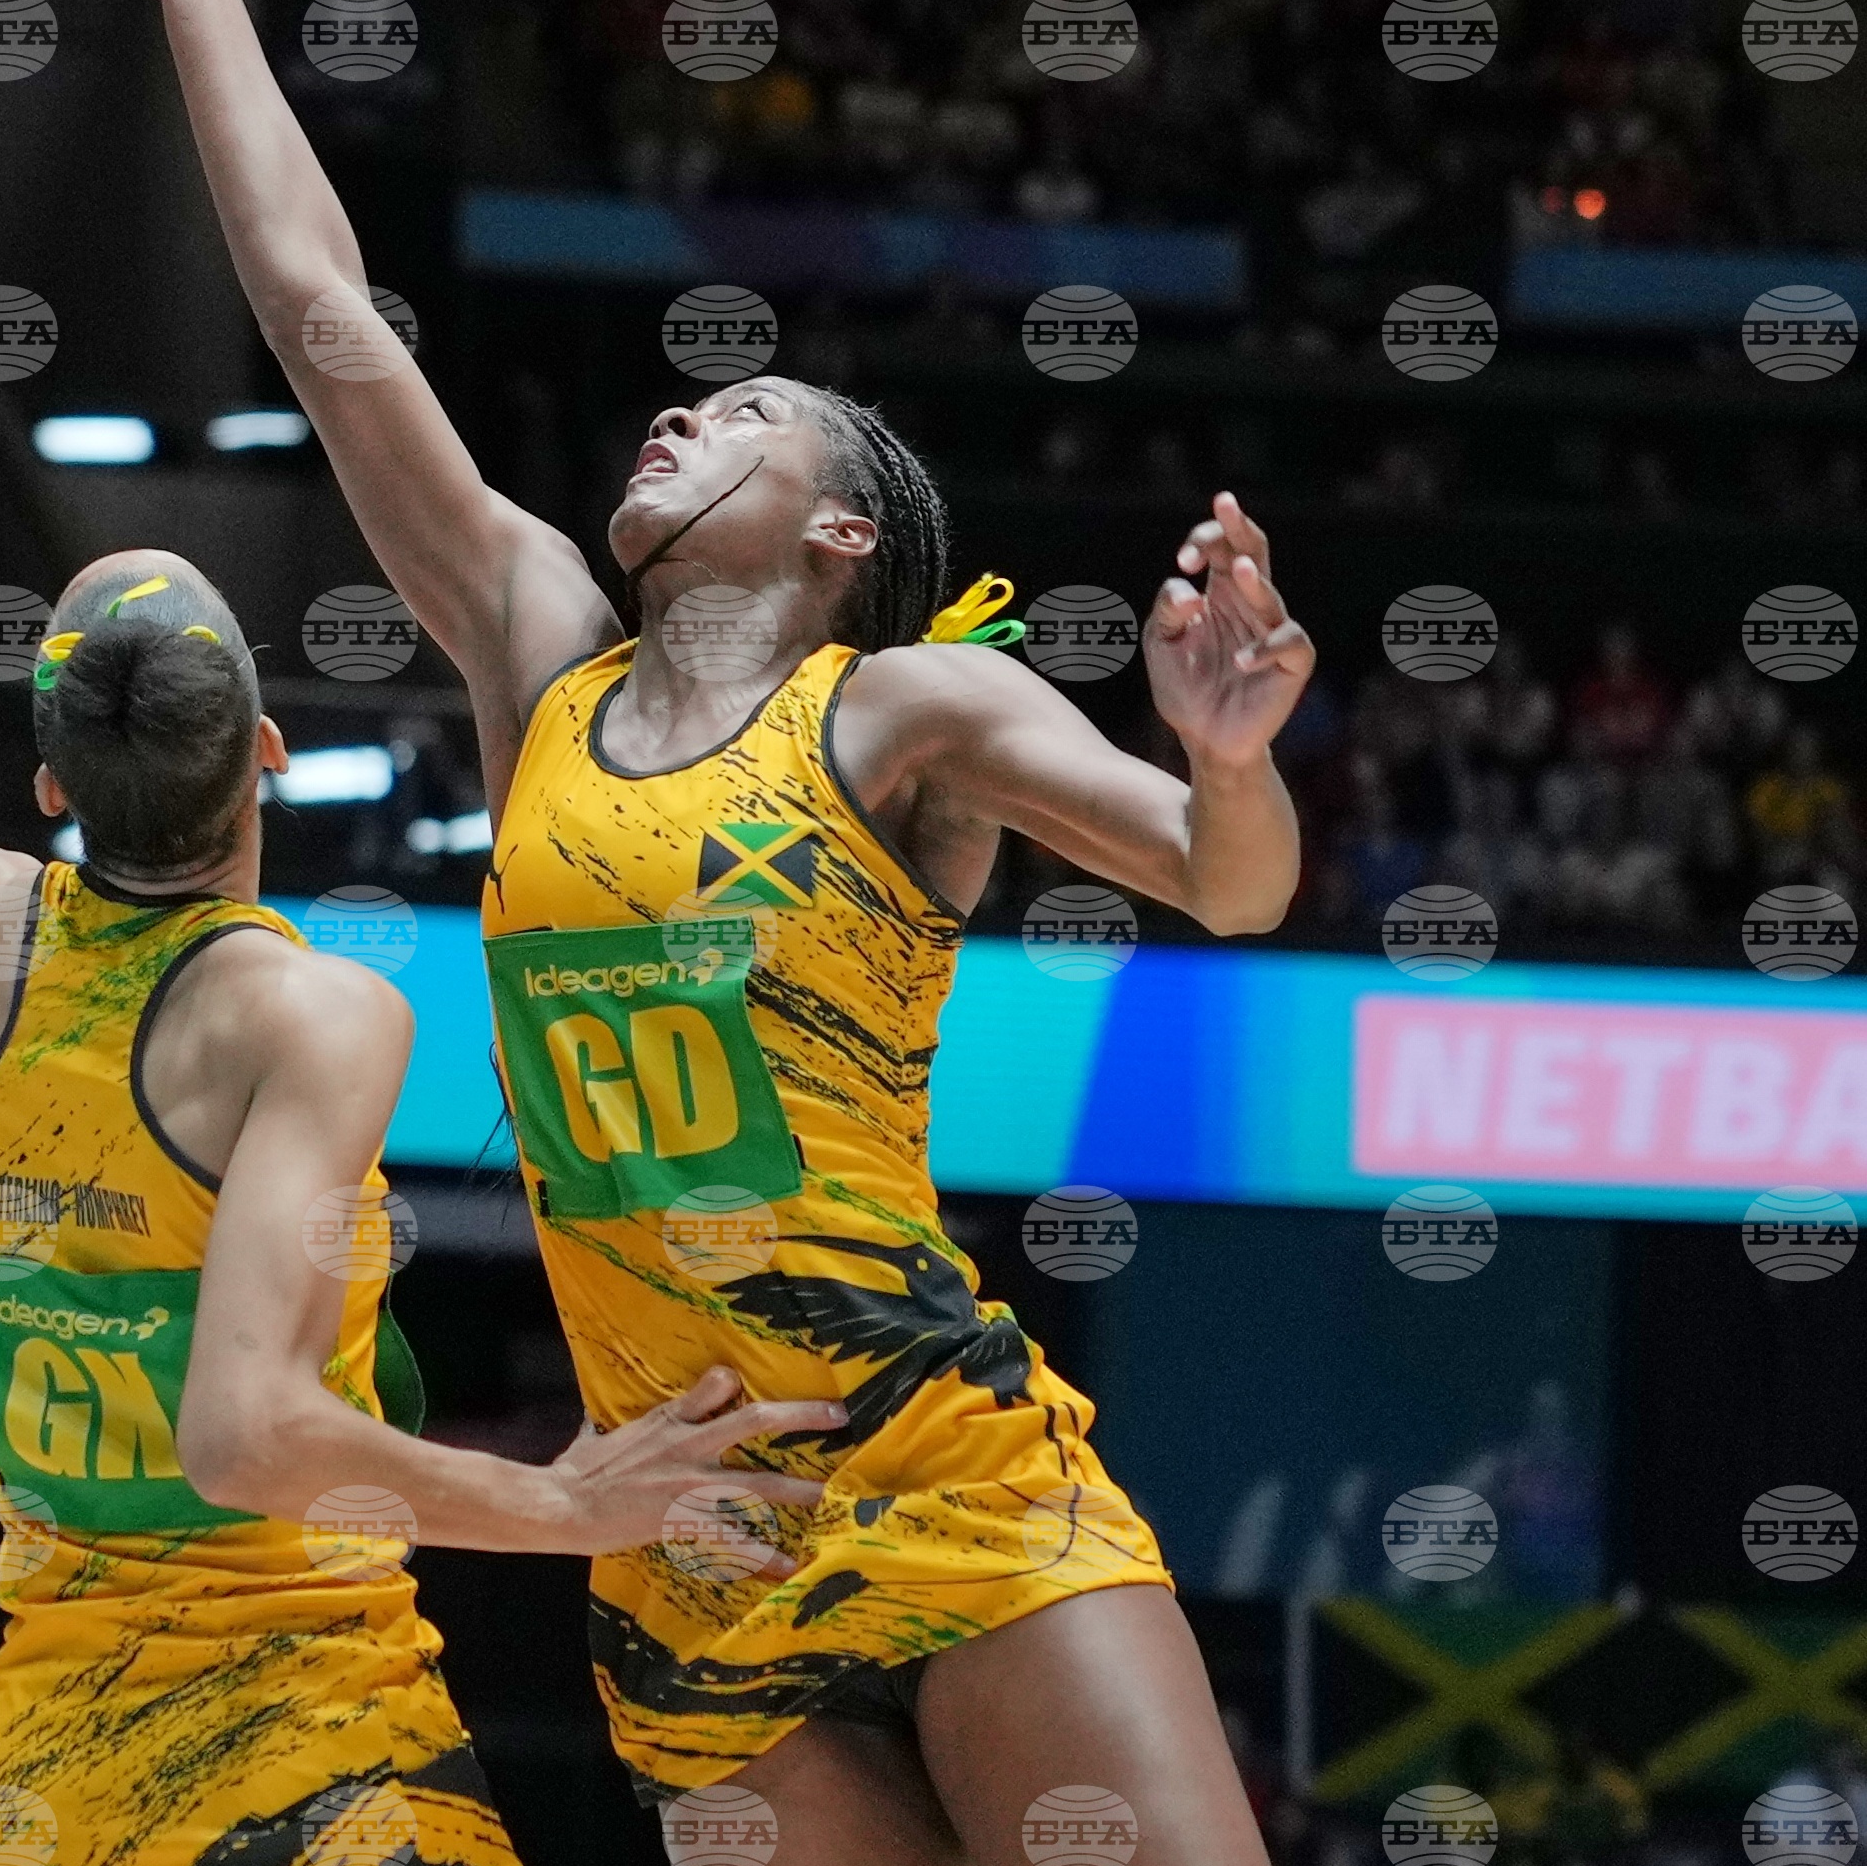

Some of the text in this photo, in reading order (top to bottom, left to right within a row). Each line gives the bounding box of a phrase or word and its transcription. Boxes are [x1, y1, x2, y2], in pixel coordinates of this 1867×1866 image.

[524, 961, 687, 998] Ideagen
[545, 1004, 739, 1163] GD
[5, 1337, 185, 1479] GN
